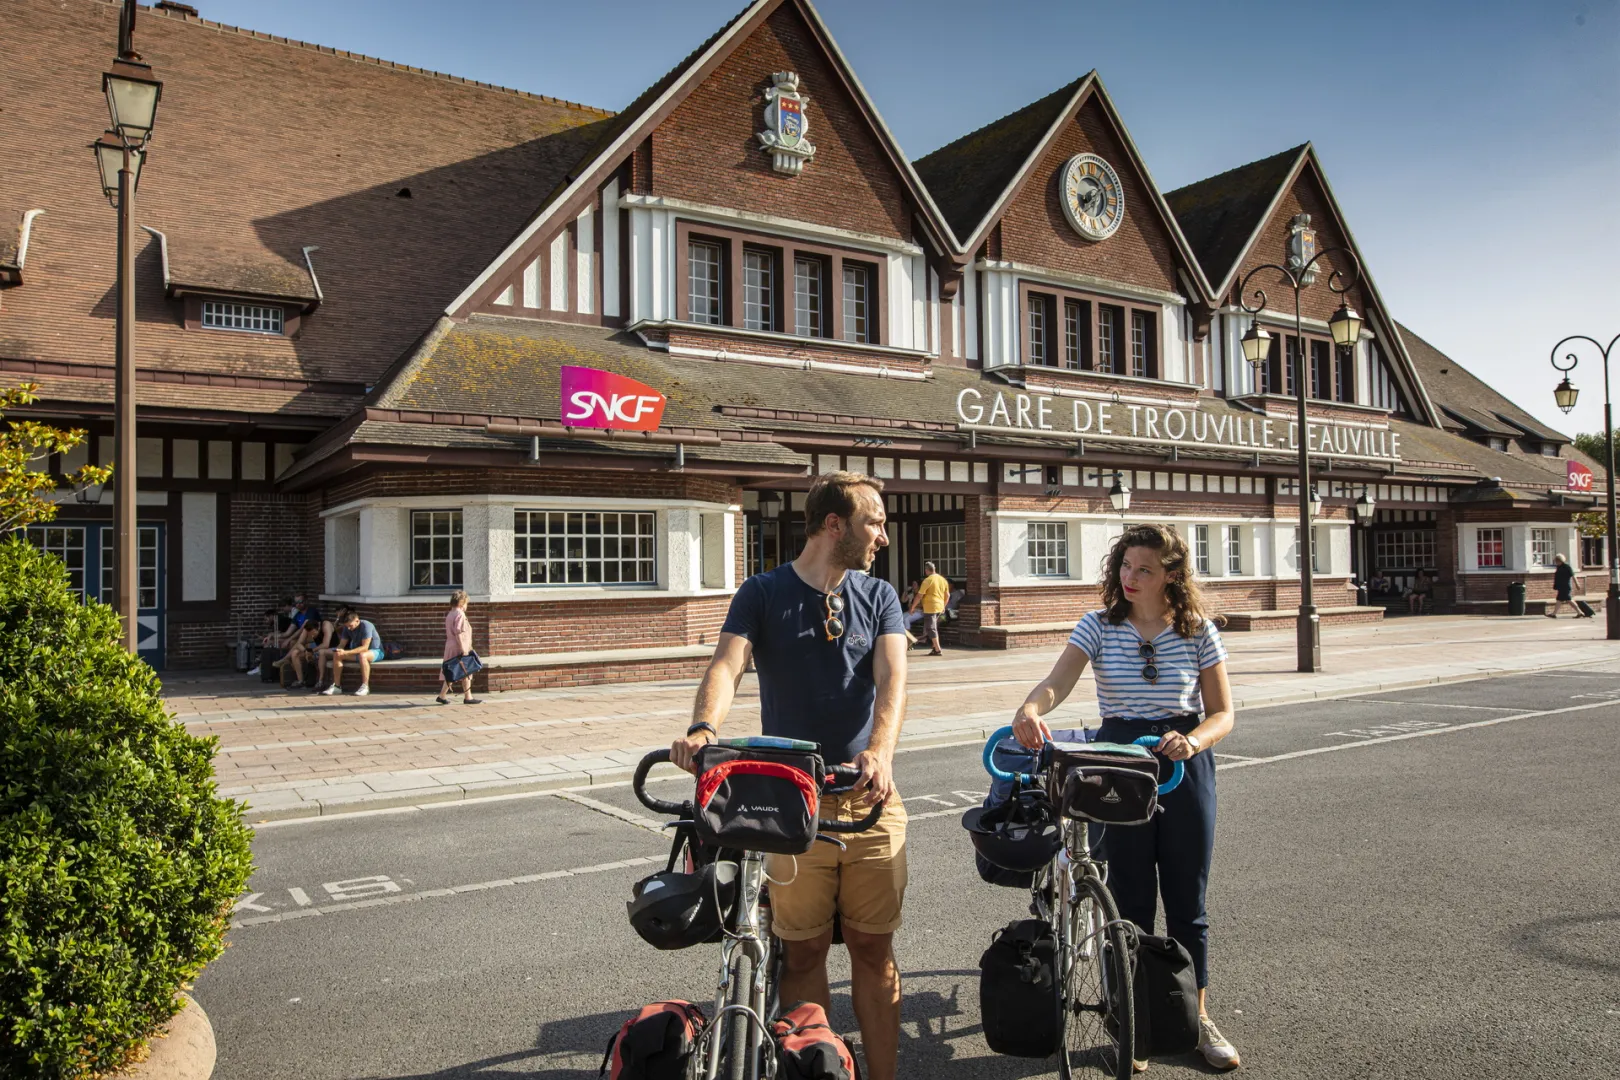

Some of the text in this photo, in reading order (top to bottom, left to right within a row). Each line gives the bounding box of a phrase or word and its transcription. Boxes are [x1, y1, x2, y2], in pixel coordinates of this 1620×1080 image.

[566, 391, 660, 423] SNCF
[957, 388, 1052, 429] GARE
[1073, 400, 1112, 434] DE
[1569, 472, 1592, 487] SNCF
